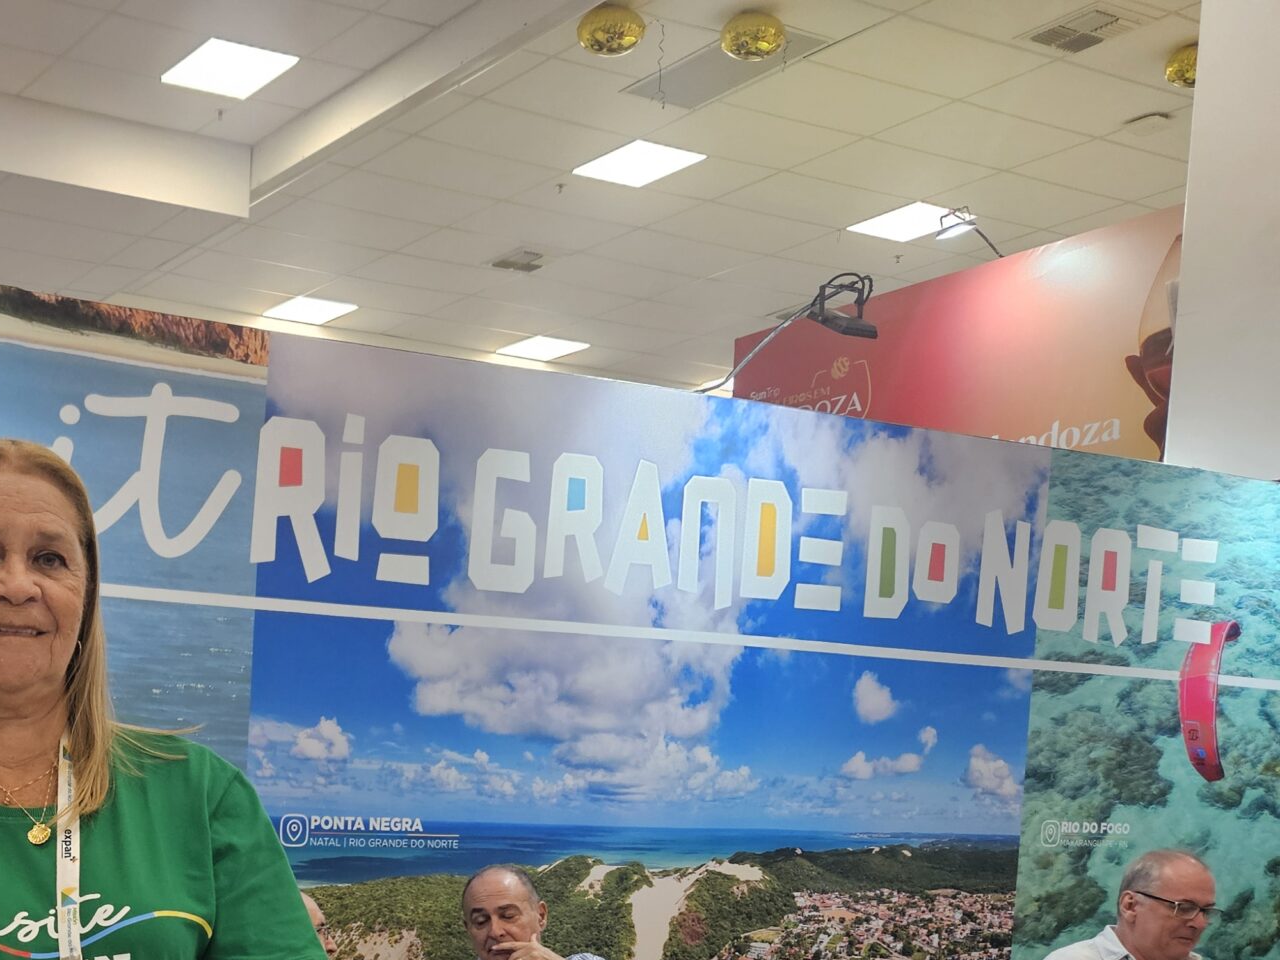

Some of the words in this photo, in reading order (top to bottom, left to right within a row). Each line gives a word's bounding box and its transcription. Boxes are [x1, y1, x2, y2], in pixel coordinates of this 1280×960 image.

[467, 447, 848, 612] GRANDE
[863, 505, 960, 619] DO
[975, 508, 1219, 648] NORTE
[310, 815, 365, 831] PONTA
[369, 816, 423, 832] NEGRA
[1061, 821, 1080, 833] RIO
[1082, 822, 1098, 834] DO
[1100, 822, 1130, 834] FOGO
[62, 828, 73, 859] expan
[310, 837, 341, 847] NATAL
[349, 838, 365, 848] RIO
[368, 838, 408, 848] GRANDE
[411, 838, 424, 848] DO
[427, 838, 459, 849] NORTE
